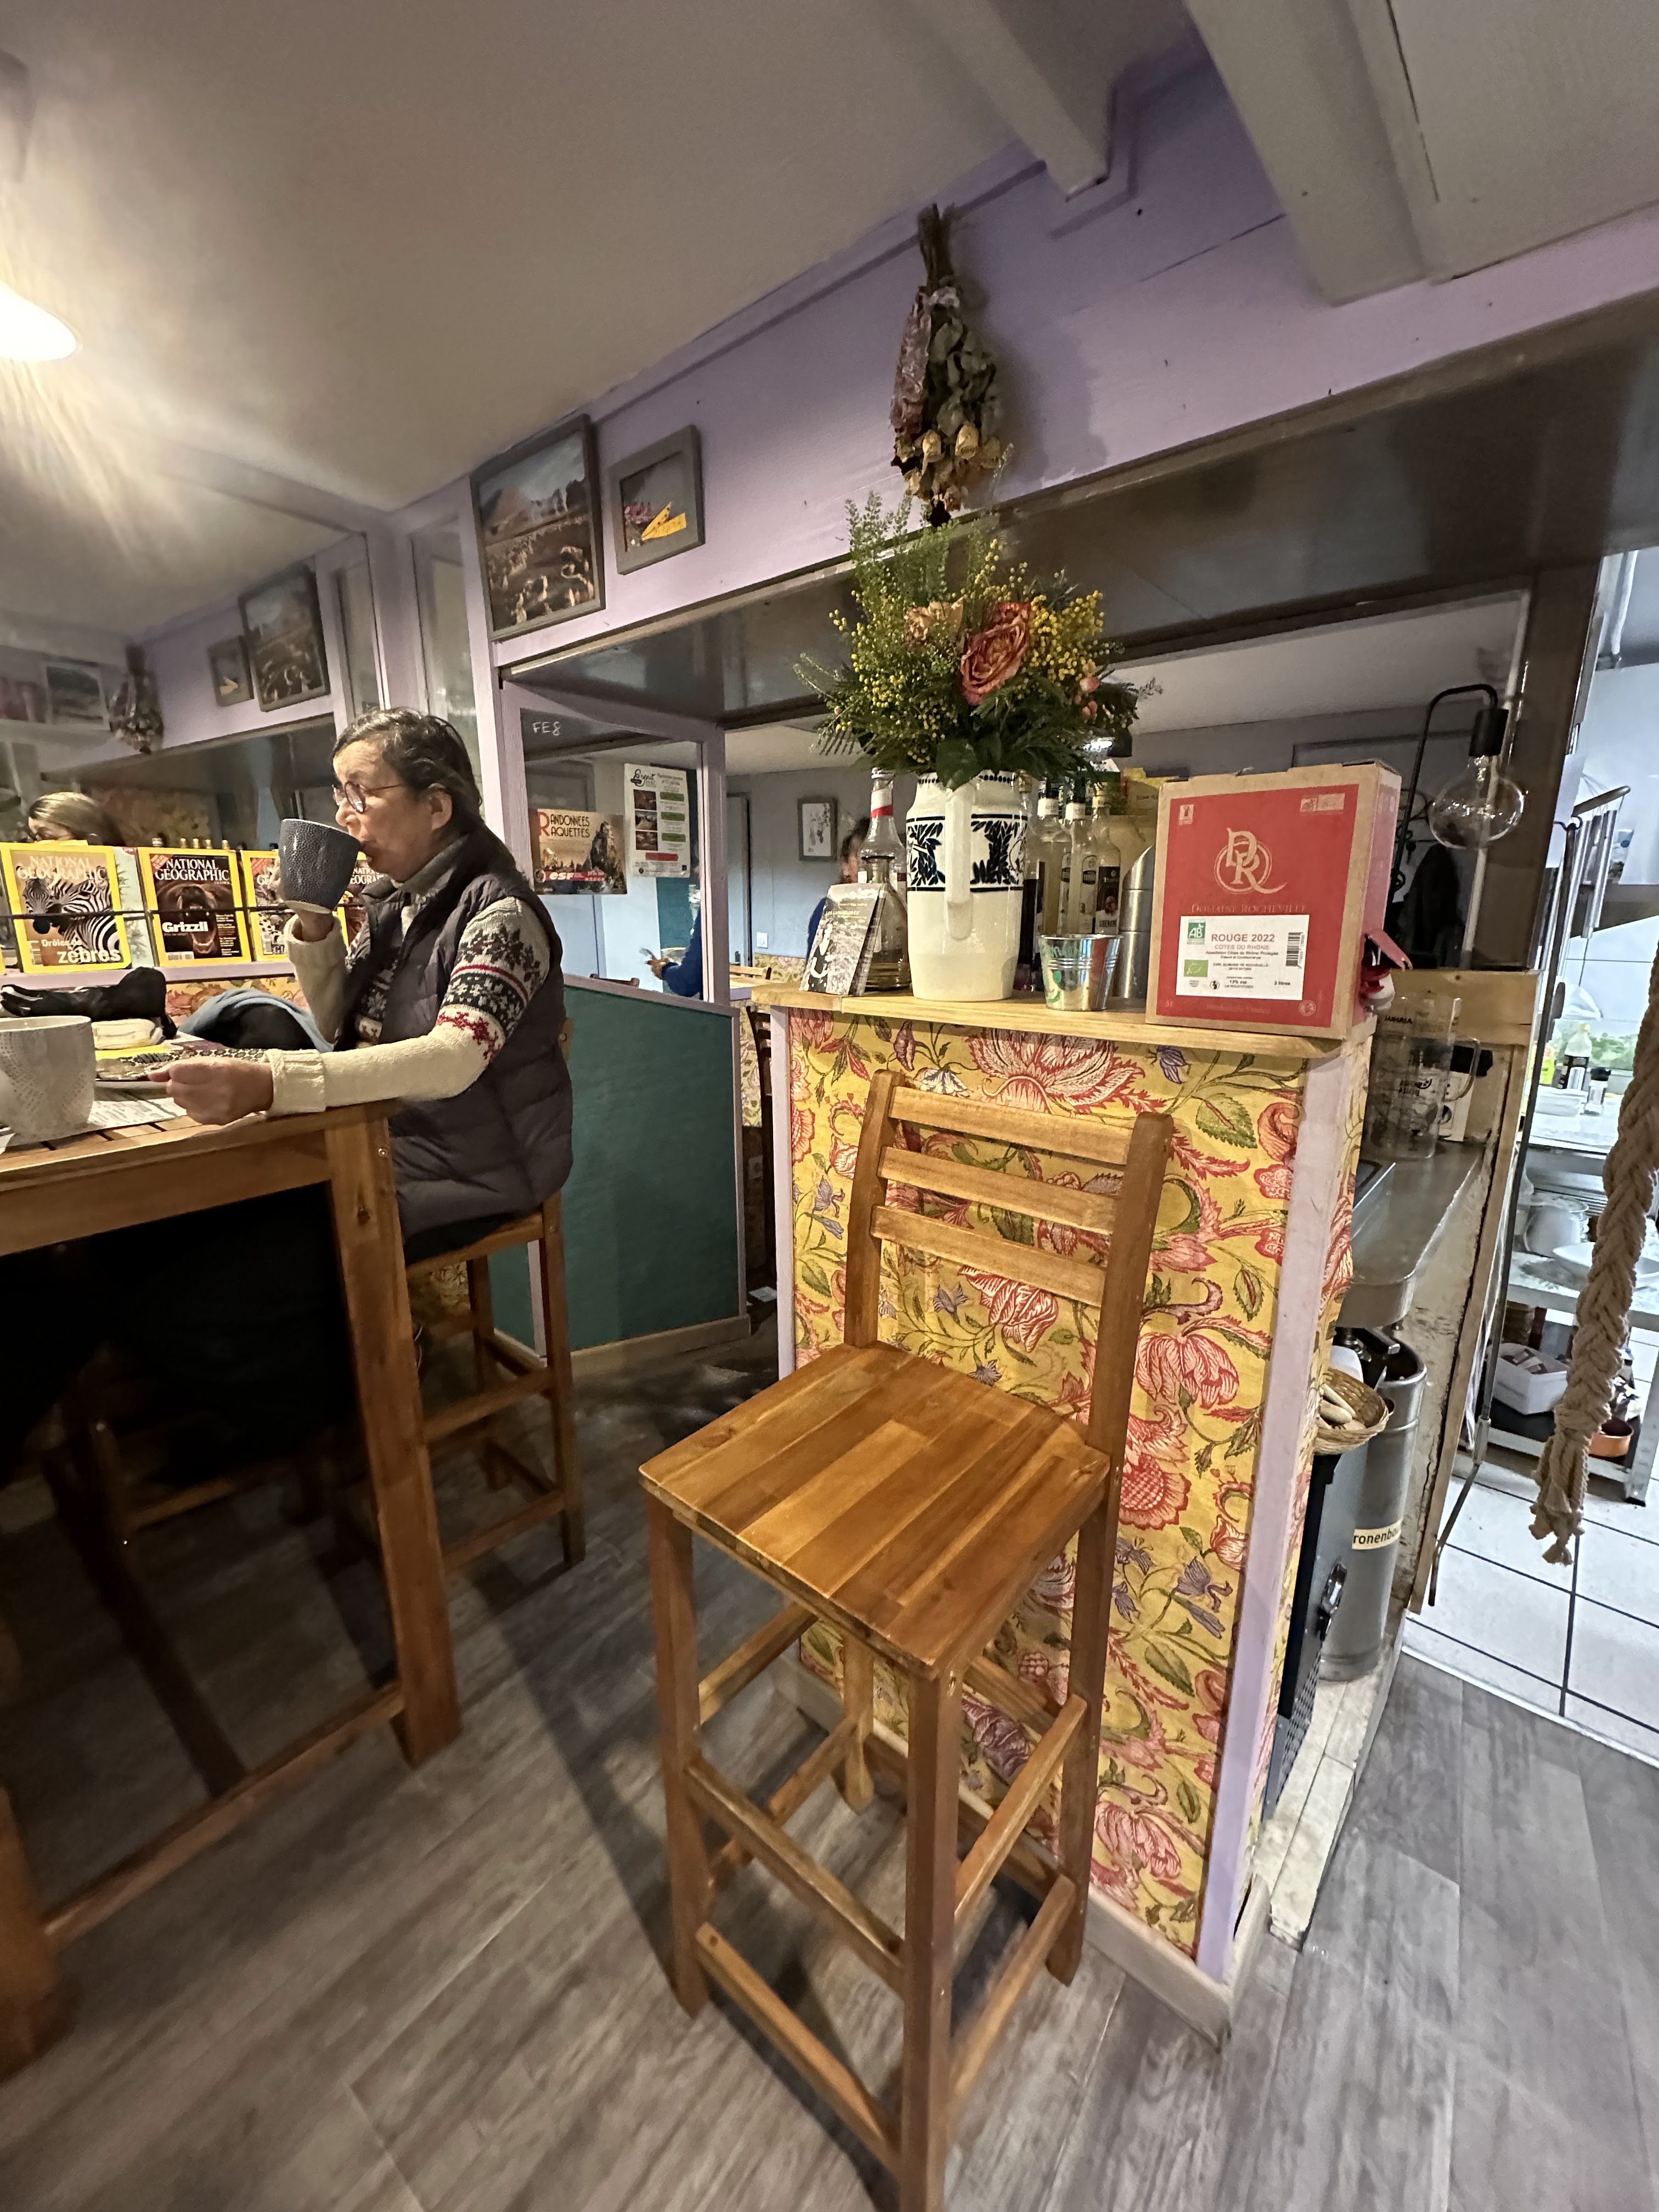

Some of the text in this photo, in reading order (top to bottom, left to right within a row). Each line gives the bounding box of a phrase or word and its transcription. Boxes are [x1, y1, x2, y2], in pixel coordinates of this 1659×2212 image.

[30, 855, 90, 867] NATIONAL
[166, 859, 219, 870] NATIONAL
[17, 866, 108, 880] GEOGRAPHIC
[155, 868, 230, 881] GEOGRAPHIC
[162, 921, 208, 933] Grizzli
[1188, 927, 1203, 938] AB
[1211, 934, 1275, 942] ROUGE 2022
